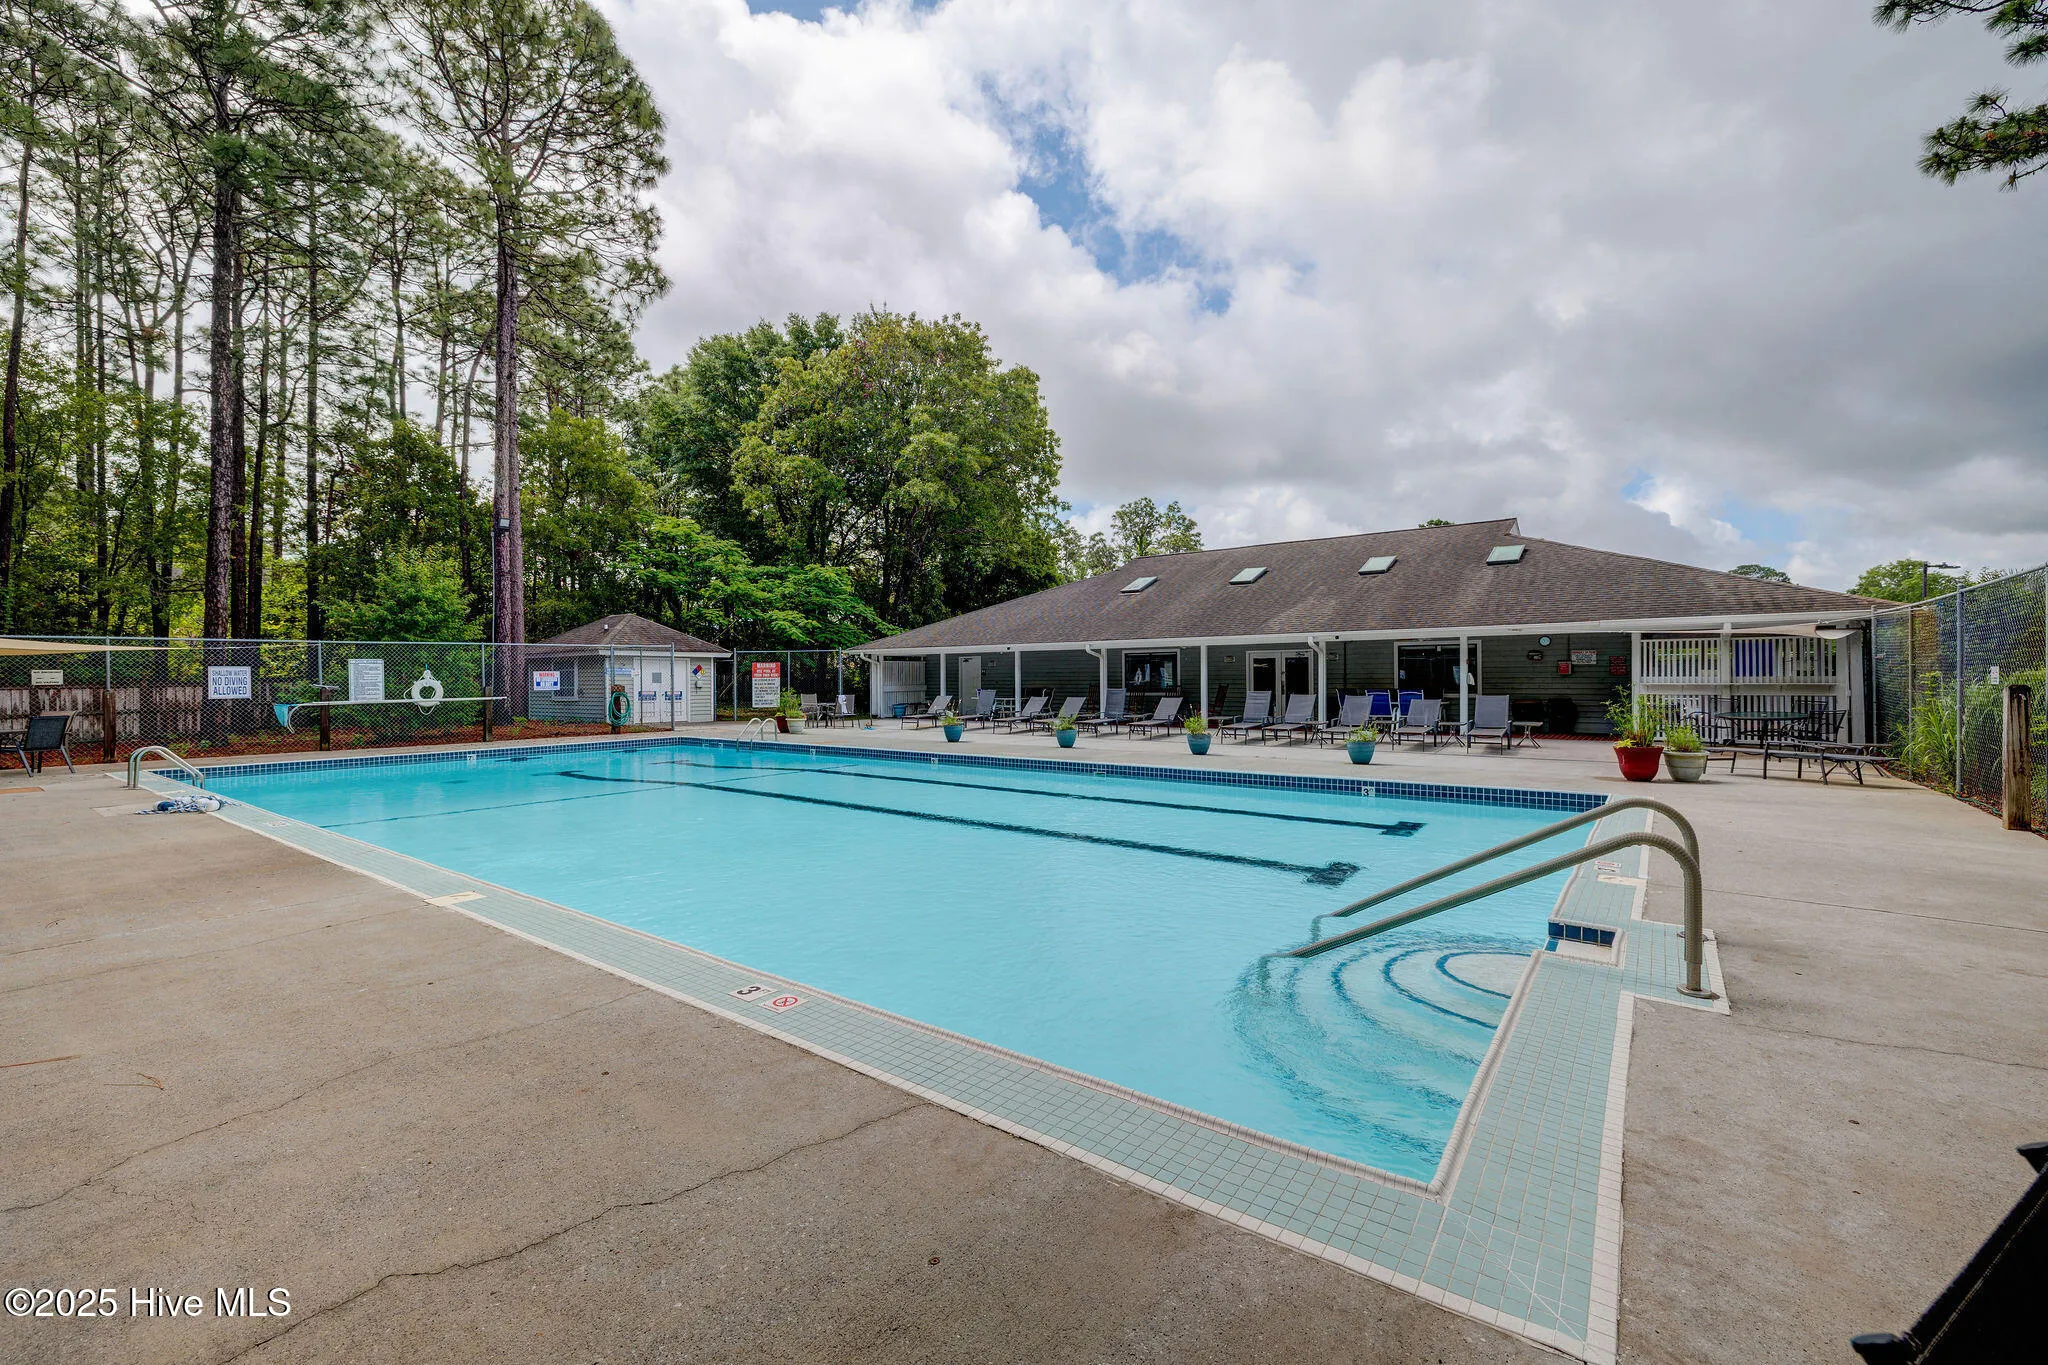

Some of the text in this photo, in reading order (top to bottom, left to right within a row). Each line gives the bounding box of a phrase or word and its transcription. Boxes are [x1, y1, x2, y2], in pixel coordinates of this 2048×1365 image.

[212, 677, 247, 685] NO DIVING
[213, 686, 247, 695] ALLOWED
[736, 986, 761, 995] 3
